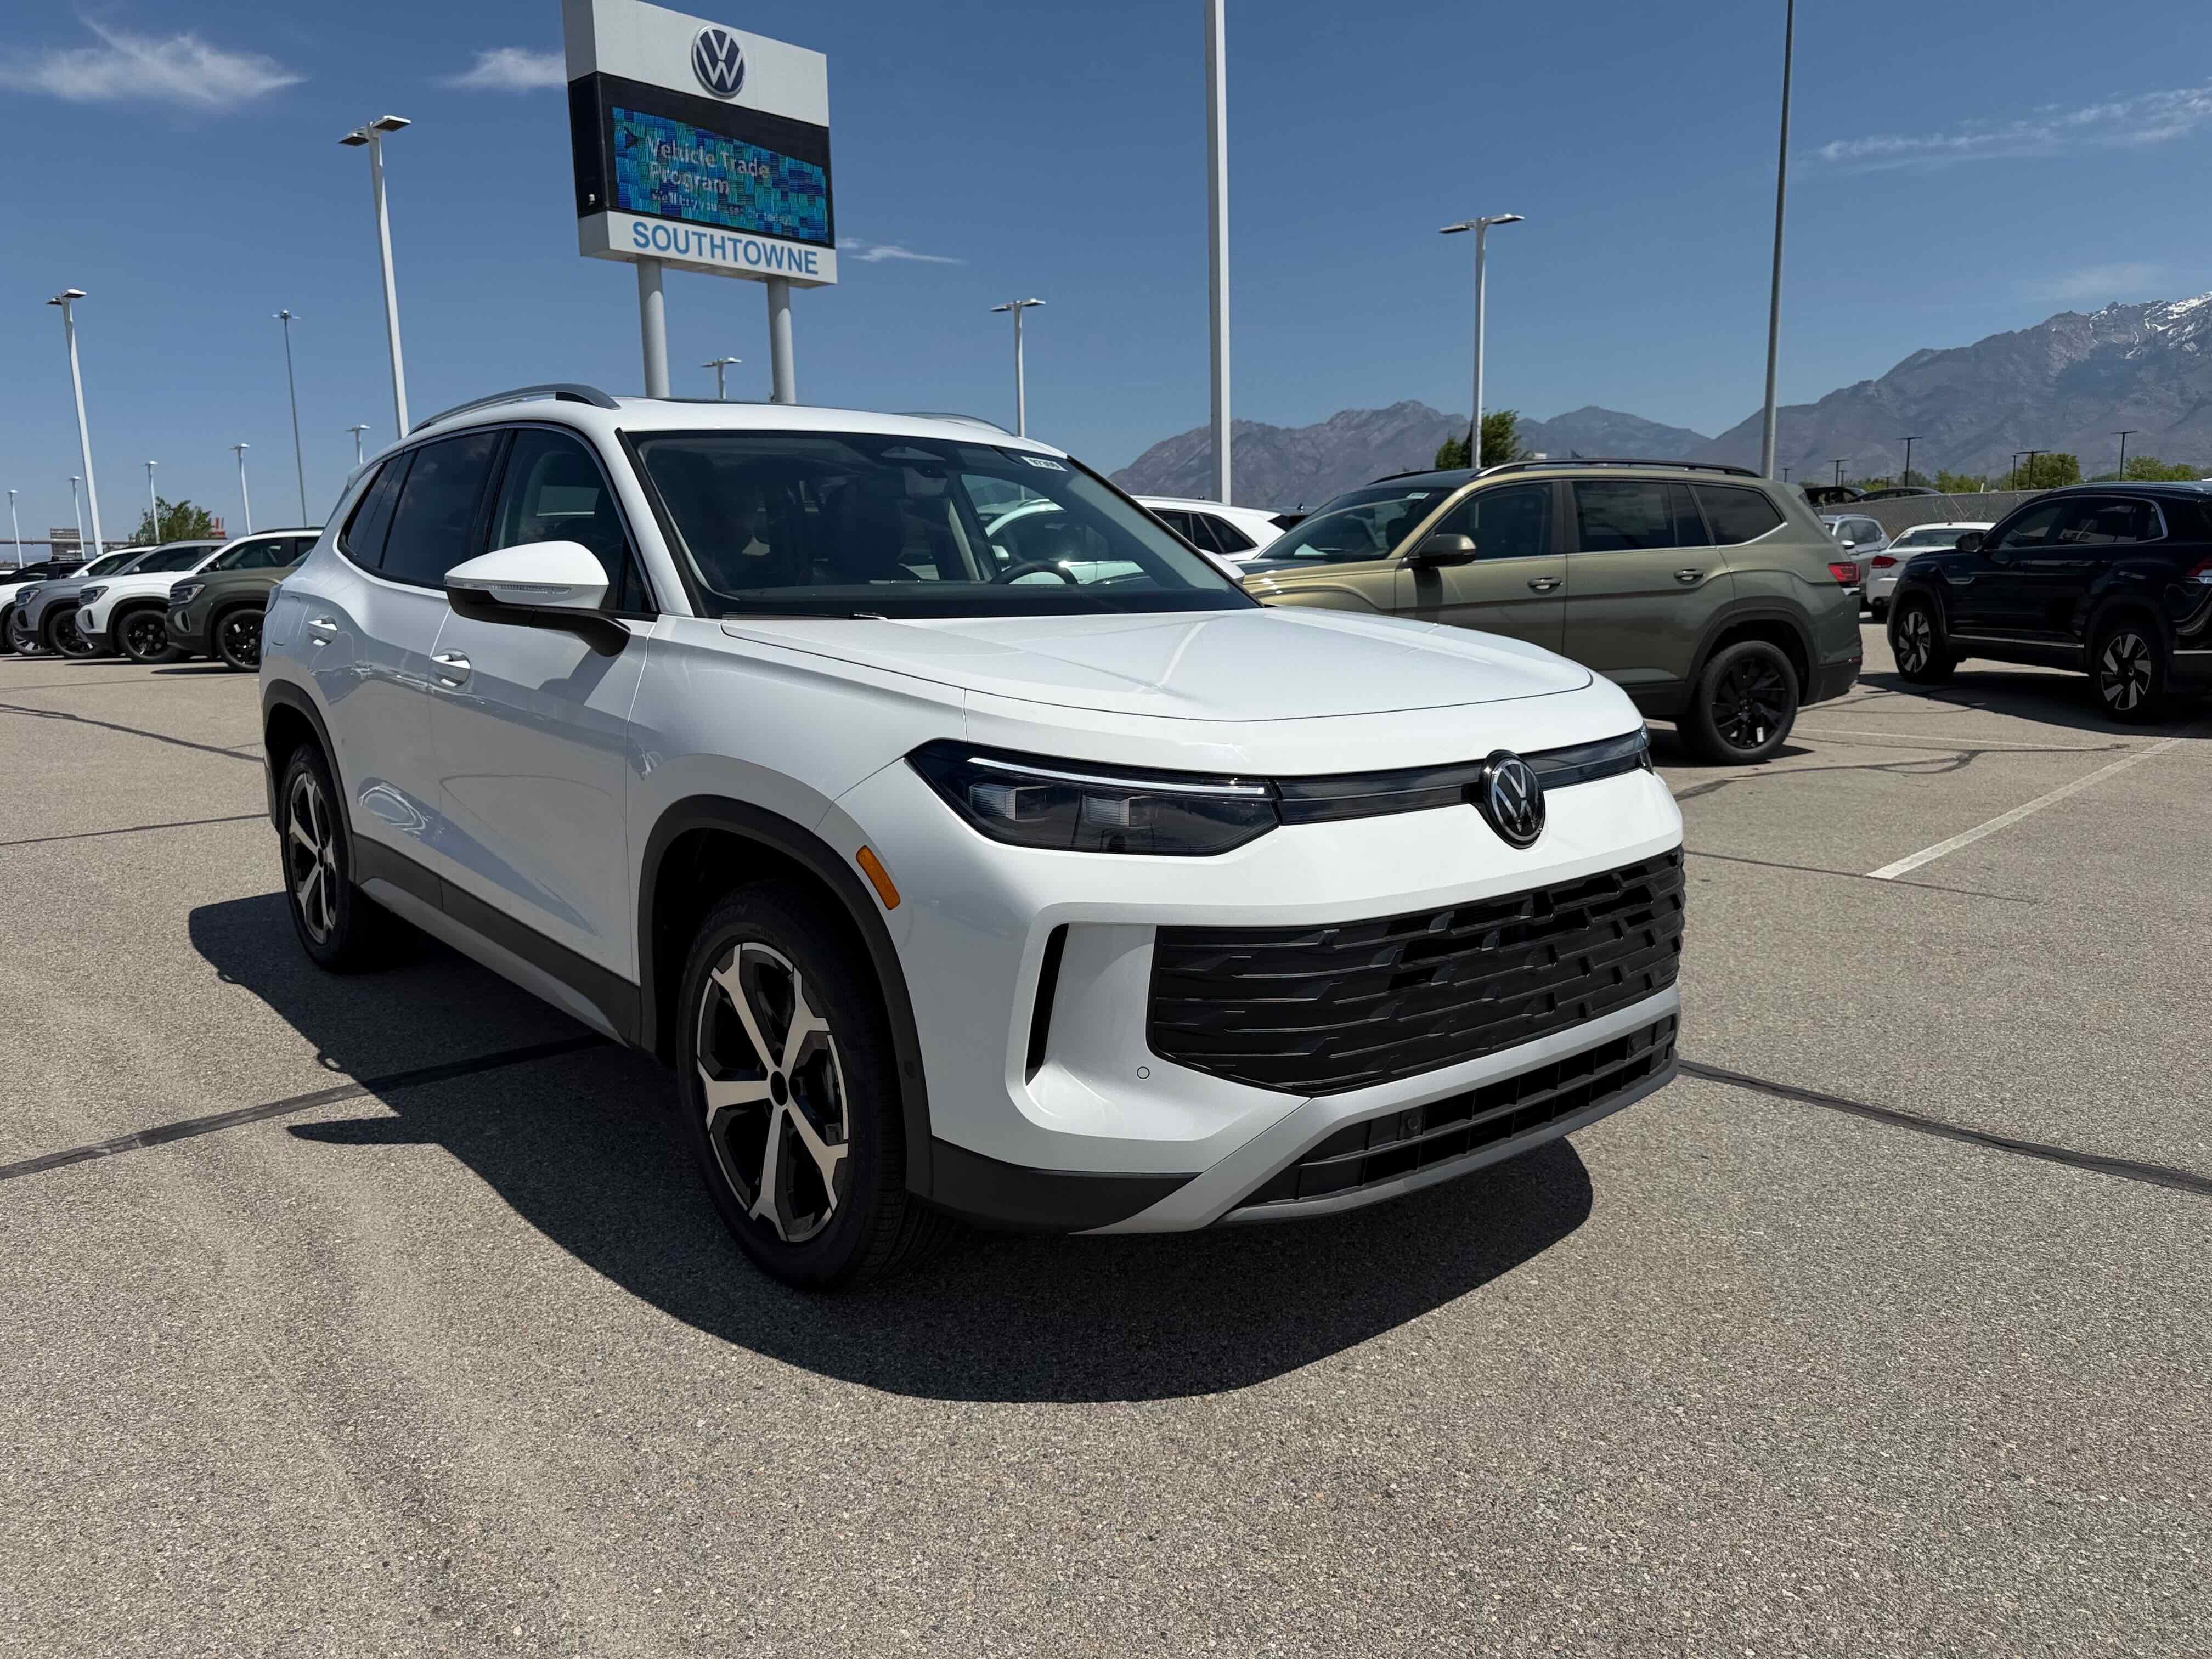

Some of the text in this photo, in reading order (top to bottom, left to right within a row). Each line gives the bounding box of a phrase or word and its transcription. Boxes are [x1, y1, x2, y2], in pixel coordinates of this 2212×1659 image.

[646, 136, 770, 177] Vehicle Trade
[648, 161, 729, 195] Program
[632, 221, 819, 275] SOUTHTOWNE
